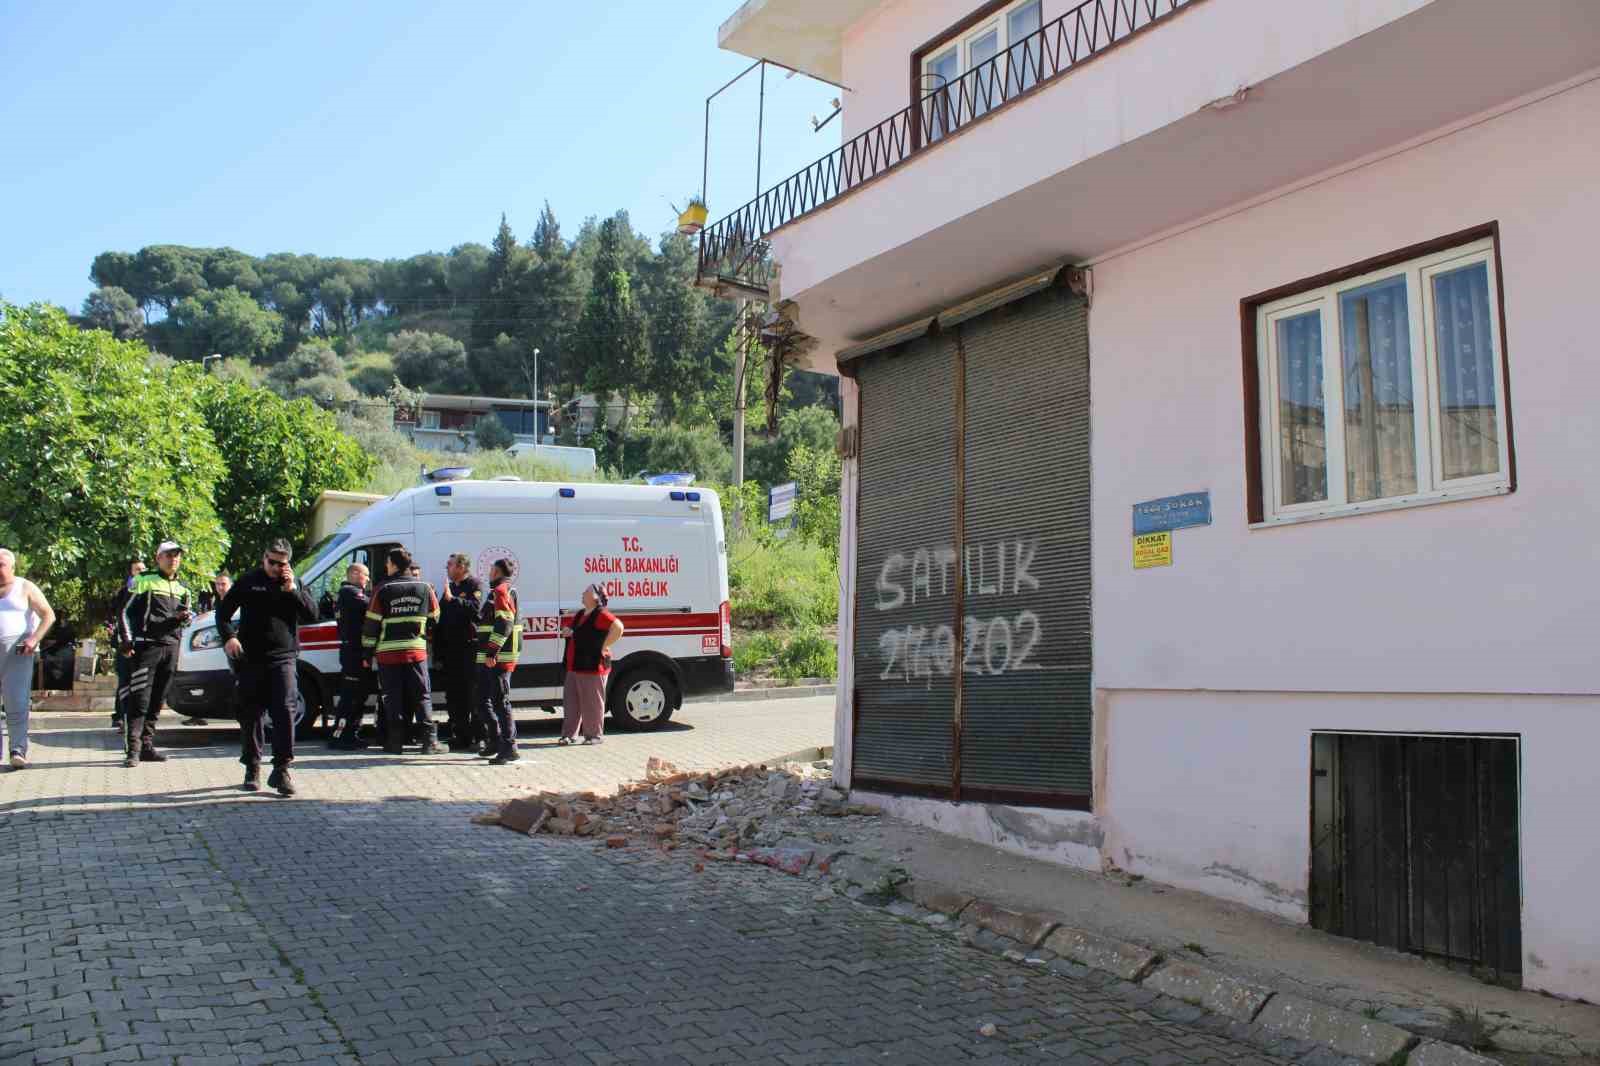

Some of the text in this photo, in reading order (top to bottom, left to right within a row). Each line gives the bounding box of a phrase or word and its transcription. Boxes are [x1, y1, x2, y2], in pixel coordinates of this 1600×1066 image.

[622, 536, 643, 552] T.C.
[584, 554, 679, 573] SAĞLIK BAKANLIĞI
[874, 541, 1040, 611] SATILIK
[627, 578, 668, 597] SAĞLIK
[704, 637, 718, 647] 112
